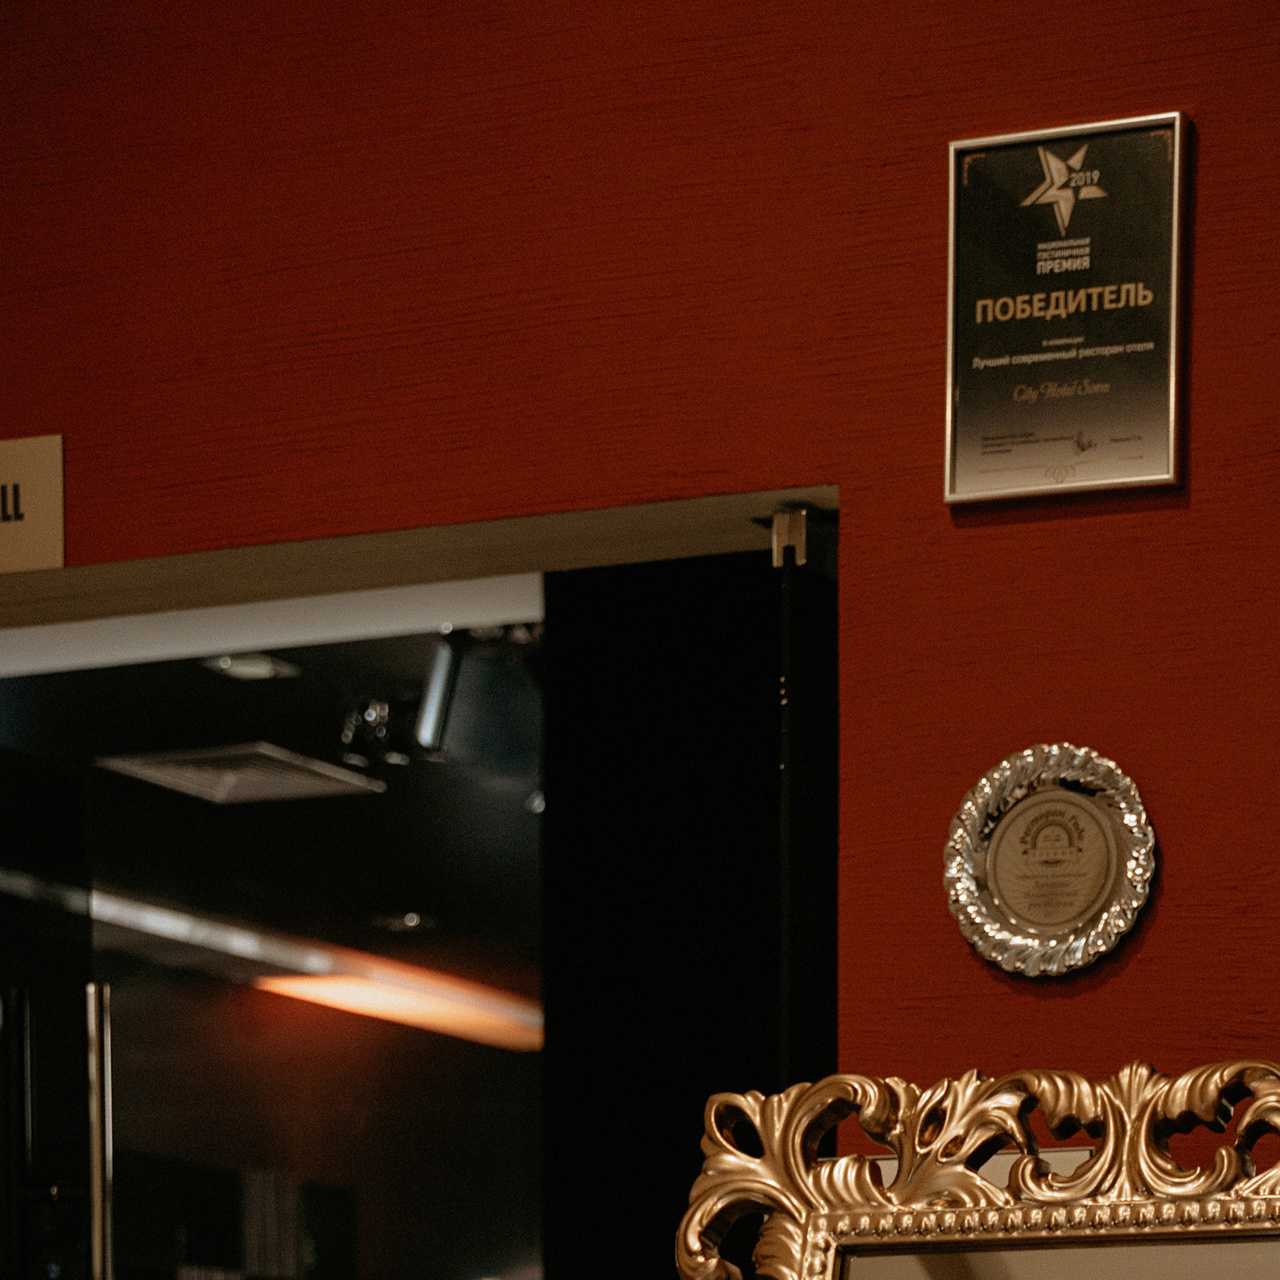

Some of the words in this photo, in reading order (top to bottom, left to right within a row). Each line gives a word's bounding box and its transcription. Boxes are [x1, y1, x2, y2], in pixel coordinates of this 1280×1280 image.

[1069, 170, 1100, 188] 2019
[1036, 256, 1091, 275] ПРЕМИЯ
[975, 282, 1155, 324] ПОБЕДИТЕЛЬ
